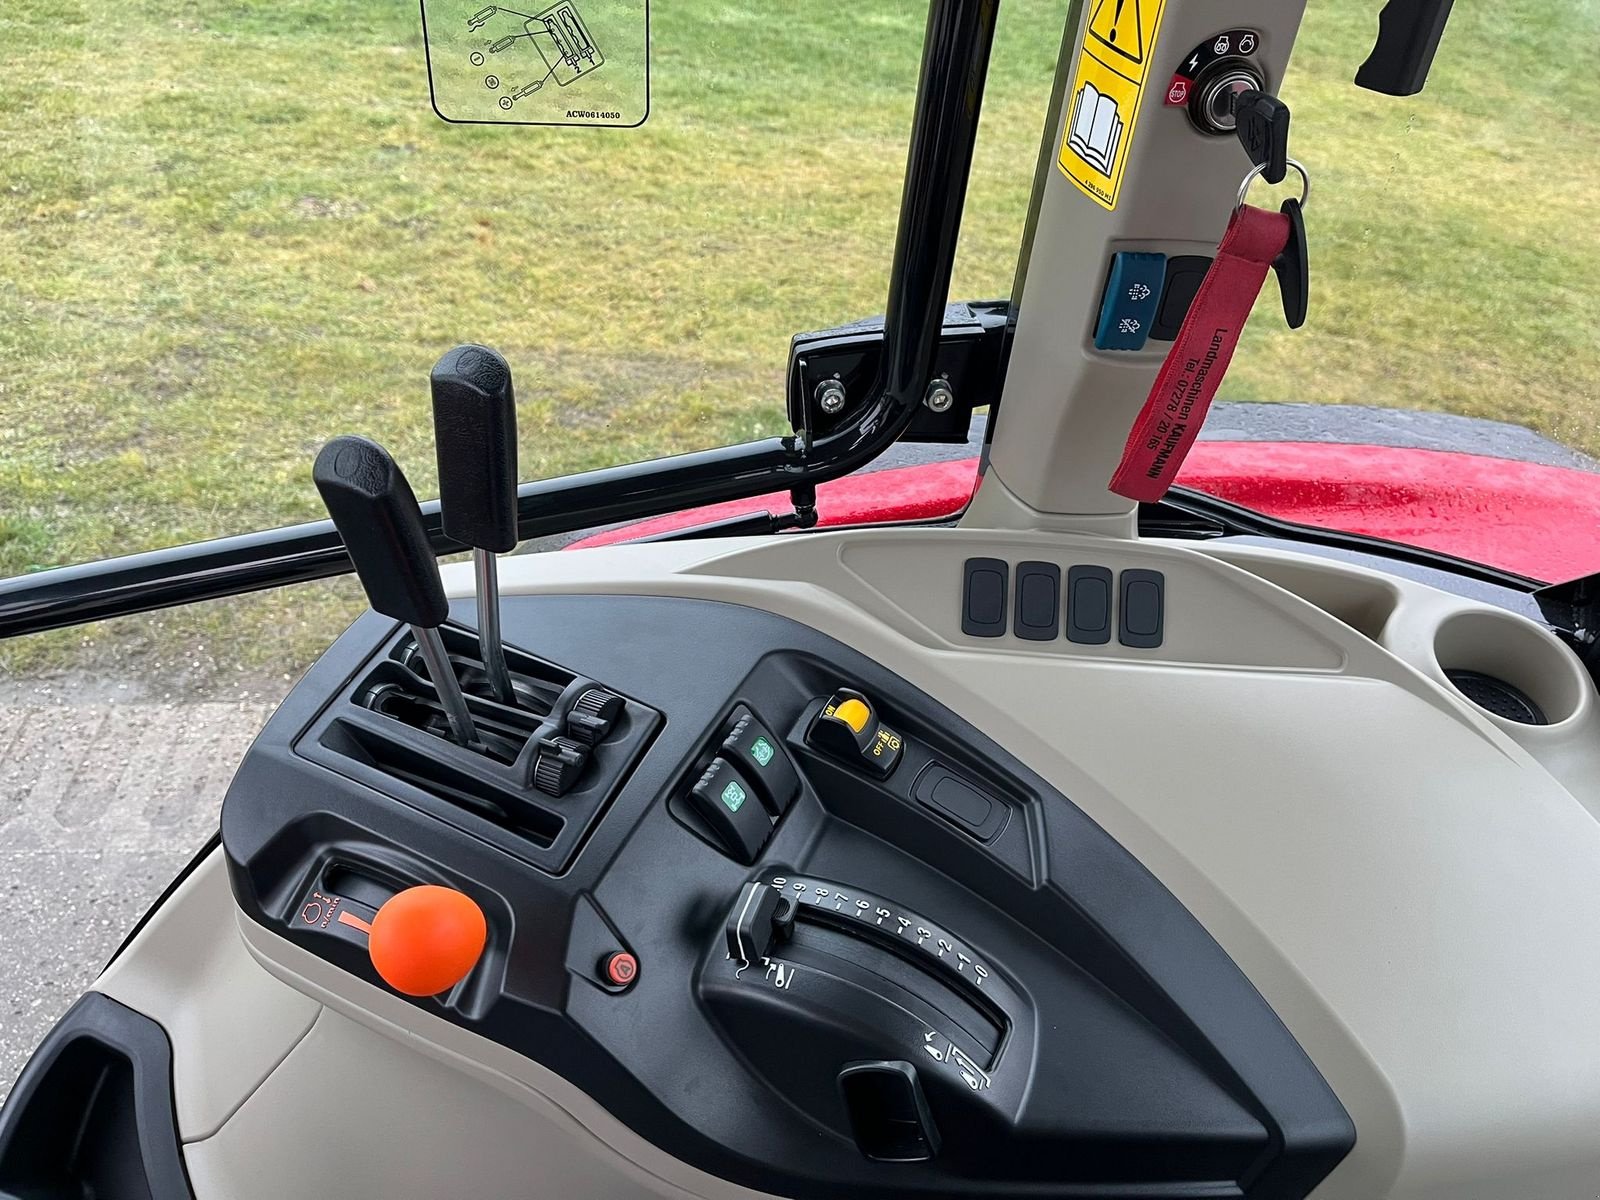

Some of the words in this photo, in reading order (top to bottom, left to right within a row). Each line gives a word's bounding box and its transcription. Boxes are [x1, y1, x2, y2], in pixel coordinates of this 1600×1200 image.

[574, 66, 582, 74] 2
[1171, 90, 1185, 98] STOP
[566, 110, 621, 119] ACW0614050
[1177, 327, 1229, 421] Landmaschinen
[1167, 379, 1189, 412] 07278
[1157, 420, 1171, 434] 20
[1146, 423, 1188, 479] KAUFMANN
[825, 704, 836, 716] ON
[873, 741, 884, 756] OFF
[320, 897, 340, 929] n/min
[771, 877, 787, 889] 10
[793, 883, 807, 891] 9
[815, 888, 829, 897] 8
[834, 893, 849, 901] 7
[855, 899, 870, 909] 6
[876, 907, 890, 918] 5
[897, 916, 911, 927] 4
[917, 927, 931, 938] 3
[938, 939, 952, 952] 2
[957, 952, 971, 964] 1
[975, 965, 988, 978] 0
